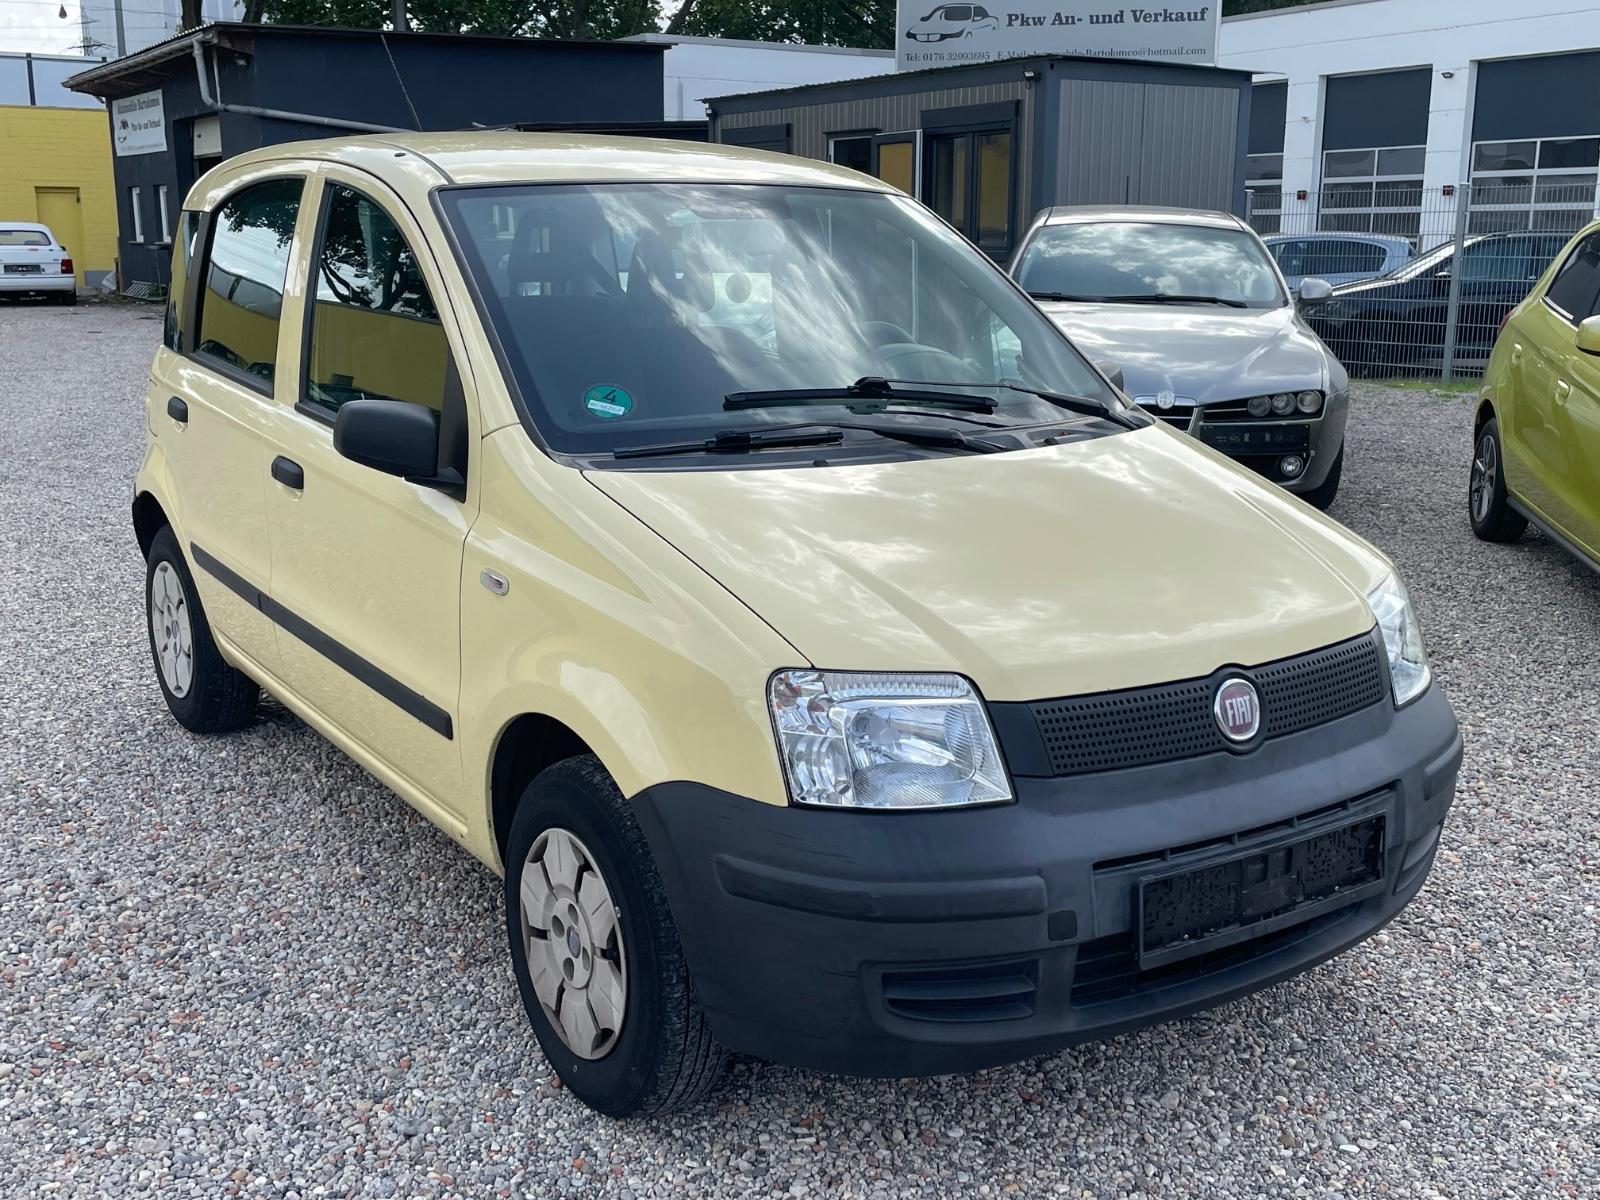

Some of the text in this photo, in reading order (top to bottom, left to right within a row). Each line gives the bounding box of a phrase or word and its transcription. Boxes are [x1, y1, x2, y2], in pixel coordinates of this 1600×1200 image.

[1006, 7, 1209, 27] Pkw An- und Verkauf
[922, 52, 945, 61] 0176
[946, 51, 990, 61] 32093695
[603, 389, 617, 404] 4
[1225, 695, 1252, 727] FIAT
